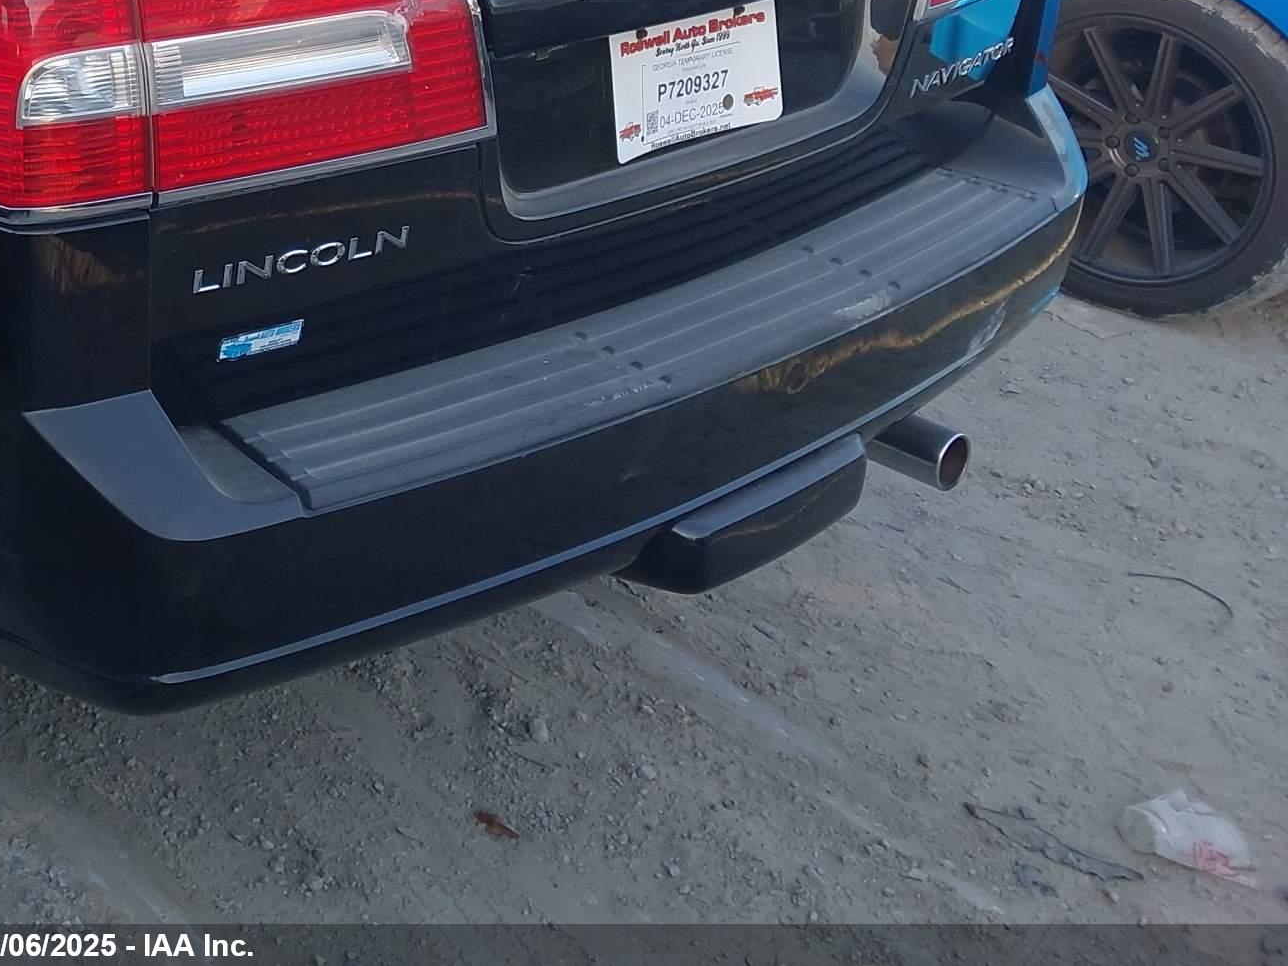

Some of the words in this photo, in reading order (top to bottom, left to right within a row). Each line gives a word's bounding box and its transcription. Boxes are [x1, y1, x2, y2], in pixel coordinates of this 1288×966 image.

[620, 29, 671, 58] Roswell
[673, 24, 707, 43] Auto
[709, 11, 766, 33] Brokers
[652, 59, 677, 72] GEORGIA
[678, 52, 711, 66] TEMPORARY
[711, 47, 735, 59] LICENSE
[910, 36, 1015, 99] NAVIGATOR
[658, 69, 729, 103] P7209327
[659, 101, 724, 129] 04-DEC-2025
[650, 121, 732, 150] RosweAutoBrokers.net
[192, 225, 410, 295] LINCOLN
